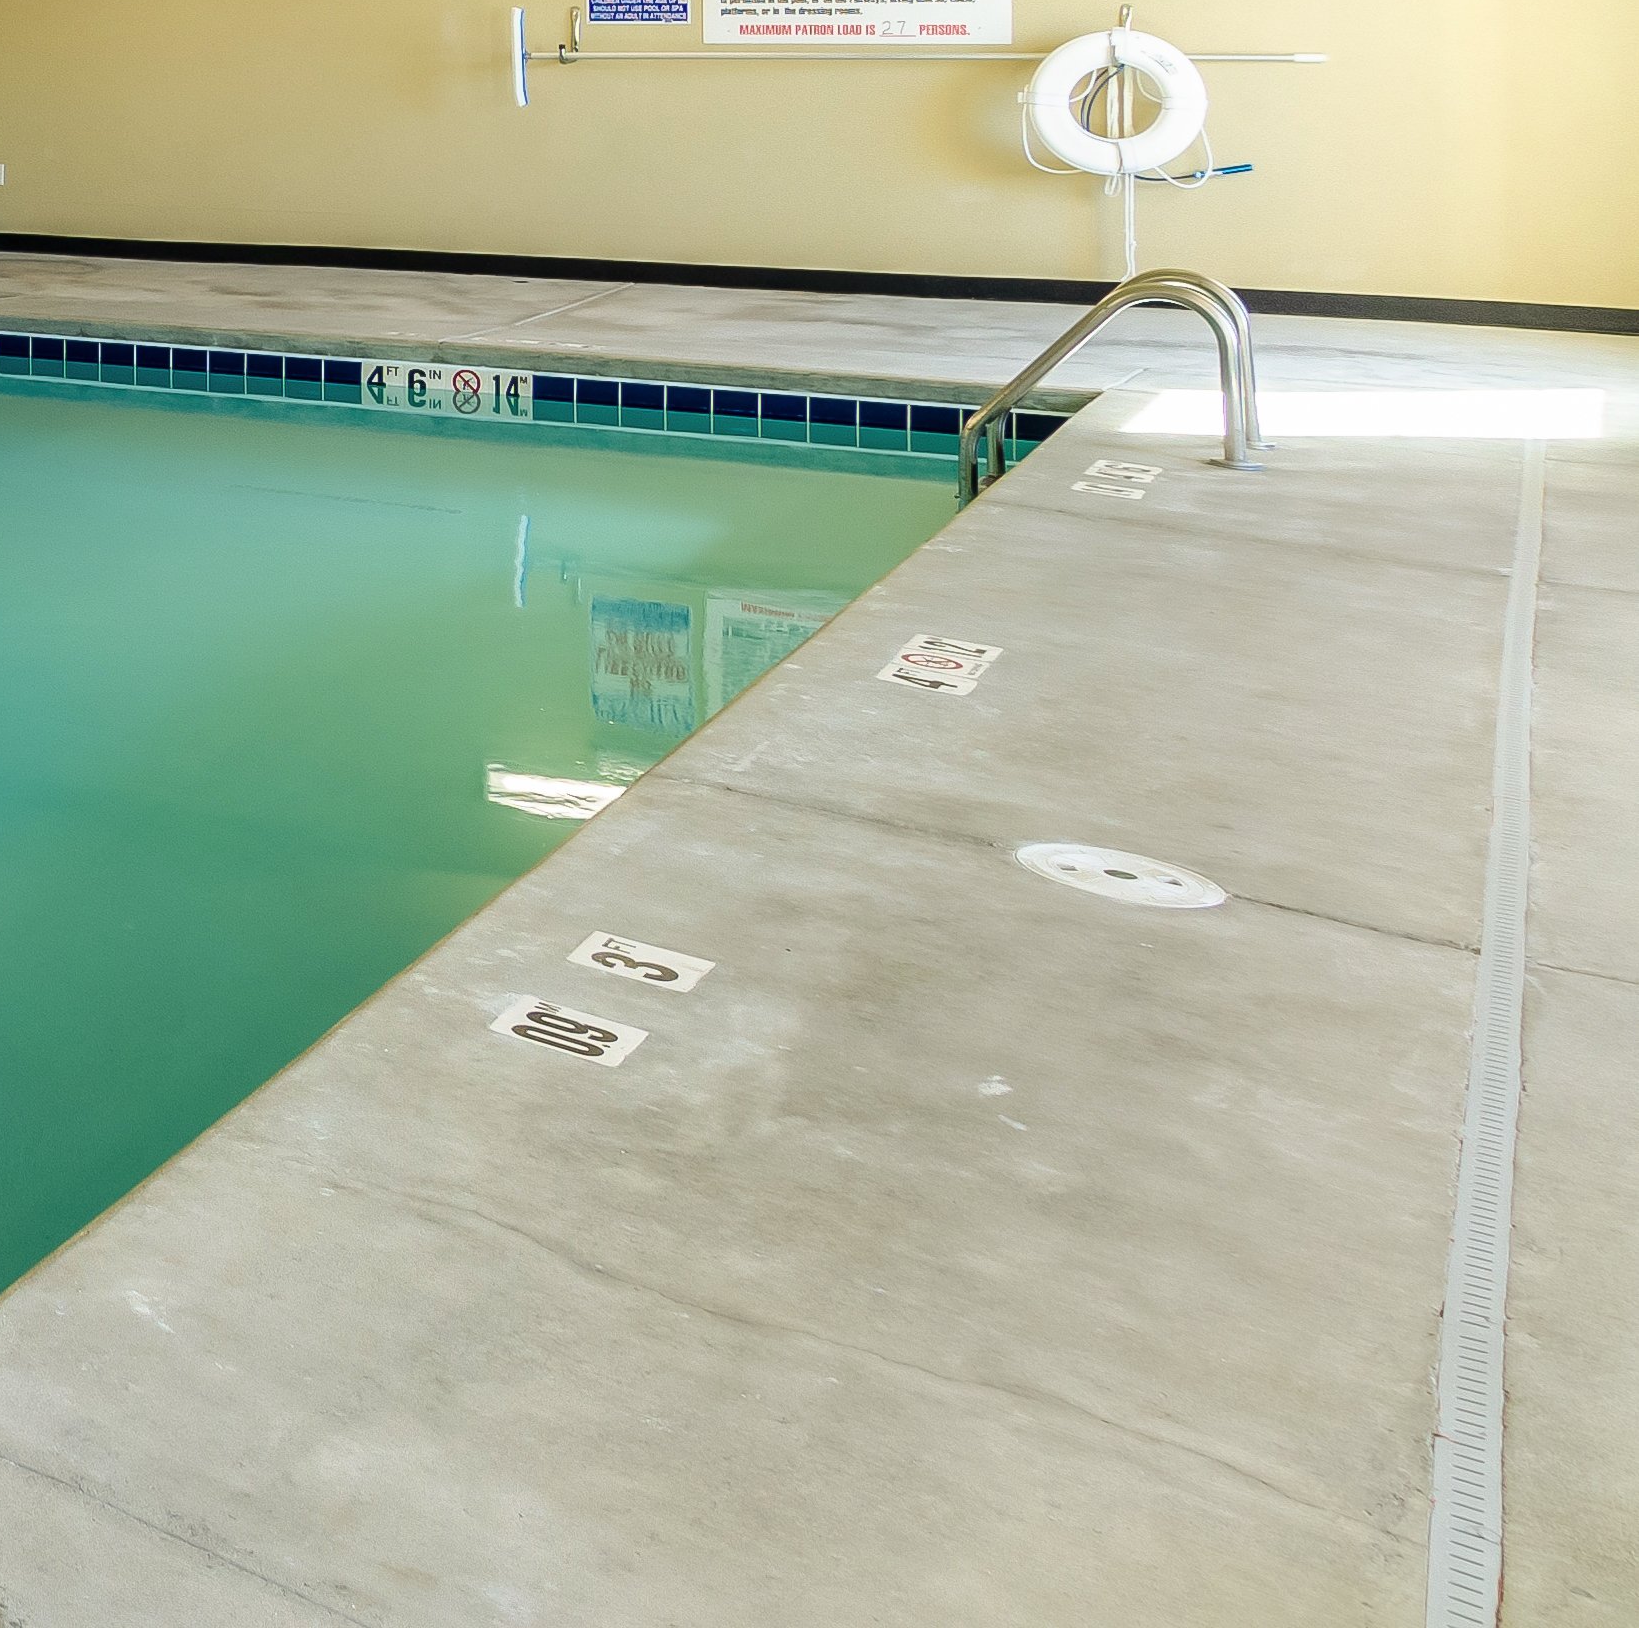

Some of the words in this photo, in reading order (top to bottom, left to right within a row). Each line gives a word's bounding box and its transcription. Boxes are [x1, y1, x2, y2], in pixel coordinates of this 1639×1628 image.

[740, 25, 792, 36] MAXIMUM
[795, 25, 834, 36] PATRON
[838, 25, 863, 36] LOAD
[866, 25, 876, 36] IS
[882, 21, 906, 35] 27
[919, 25, 971, 36] PERSONS.
[367, 366, 386, 388] 4
[429, 370, 441, 380] IN
[492, 374, 520, 397] 14
[891, 673, 958, 689] 4
[602, 937, 637, 954] FT
[591, 951, 679, 982] 3
